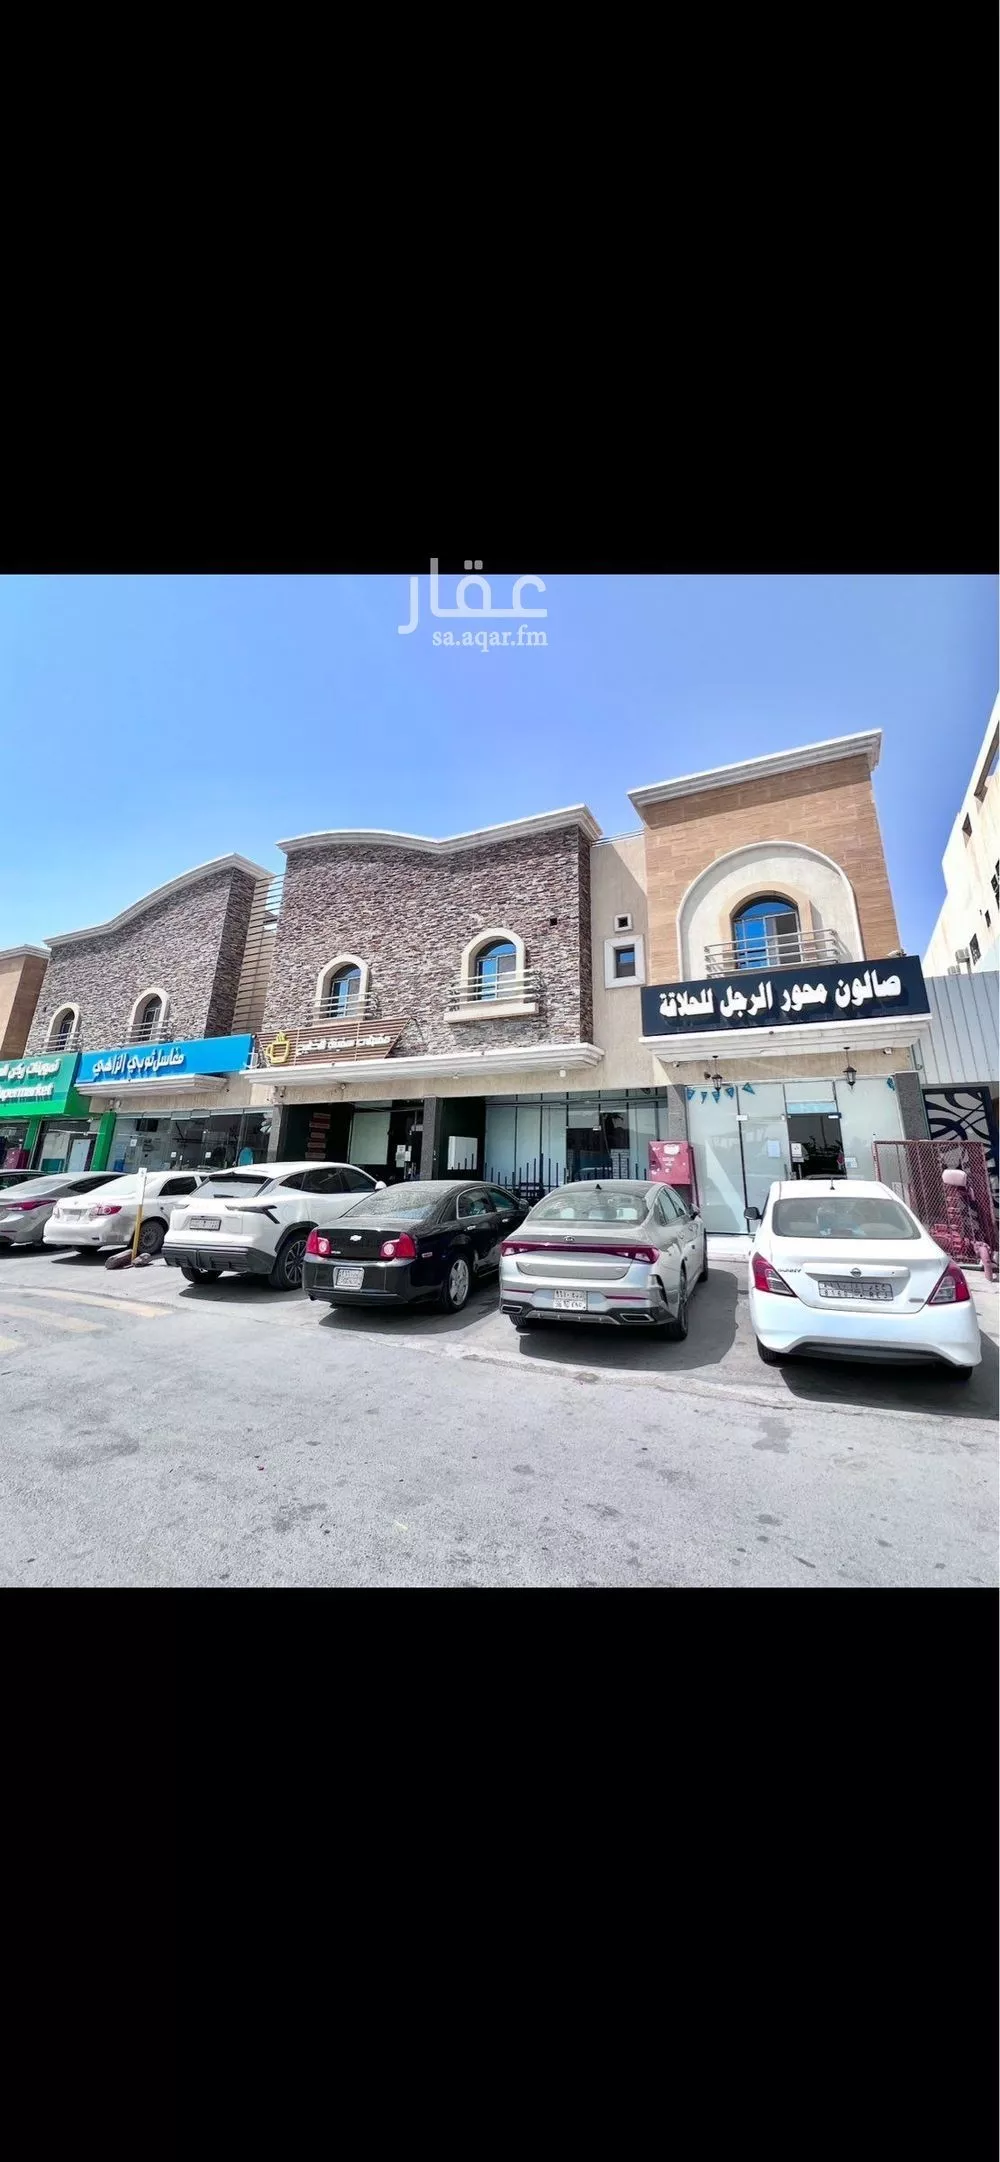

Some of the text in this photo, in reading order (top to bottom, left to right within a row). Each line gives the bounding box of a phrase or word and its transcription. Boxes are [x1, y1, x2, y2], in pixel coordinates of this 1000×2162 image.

[658, 968, 901, 1018] صالون محور الرجل للحلاقة
[26, 1057, 62, 1076] تموينات
[92, 1052, 127, 1076] الزاهي
[152, 1047, 185, 1072] مغاسل
